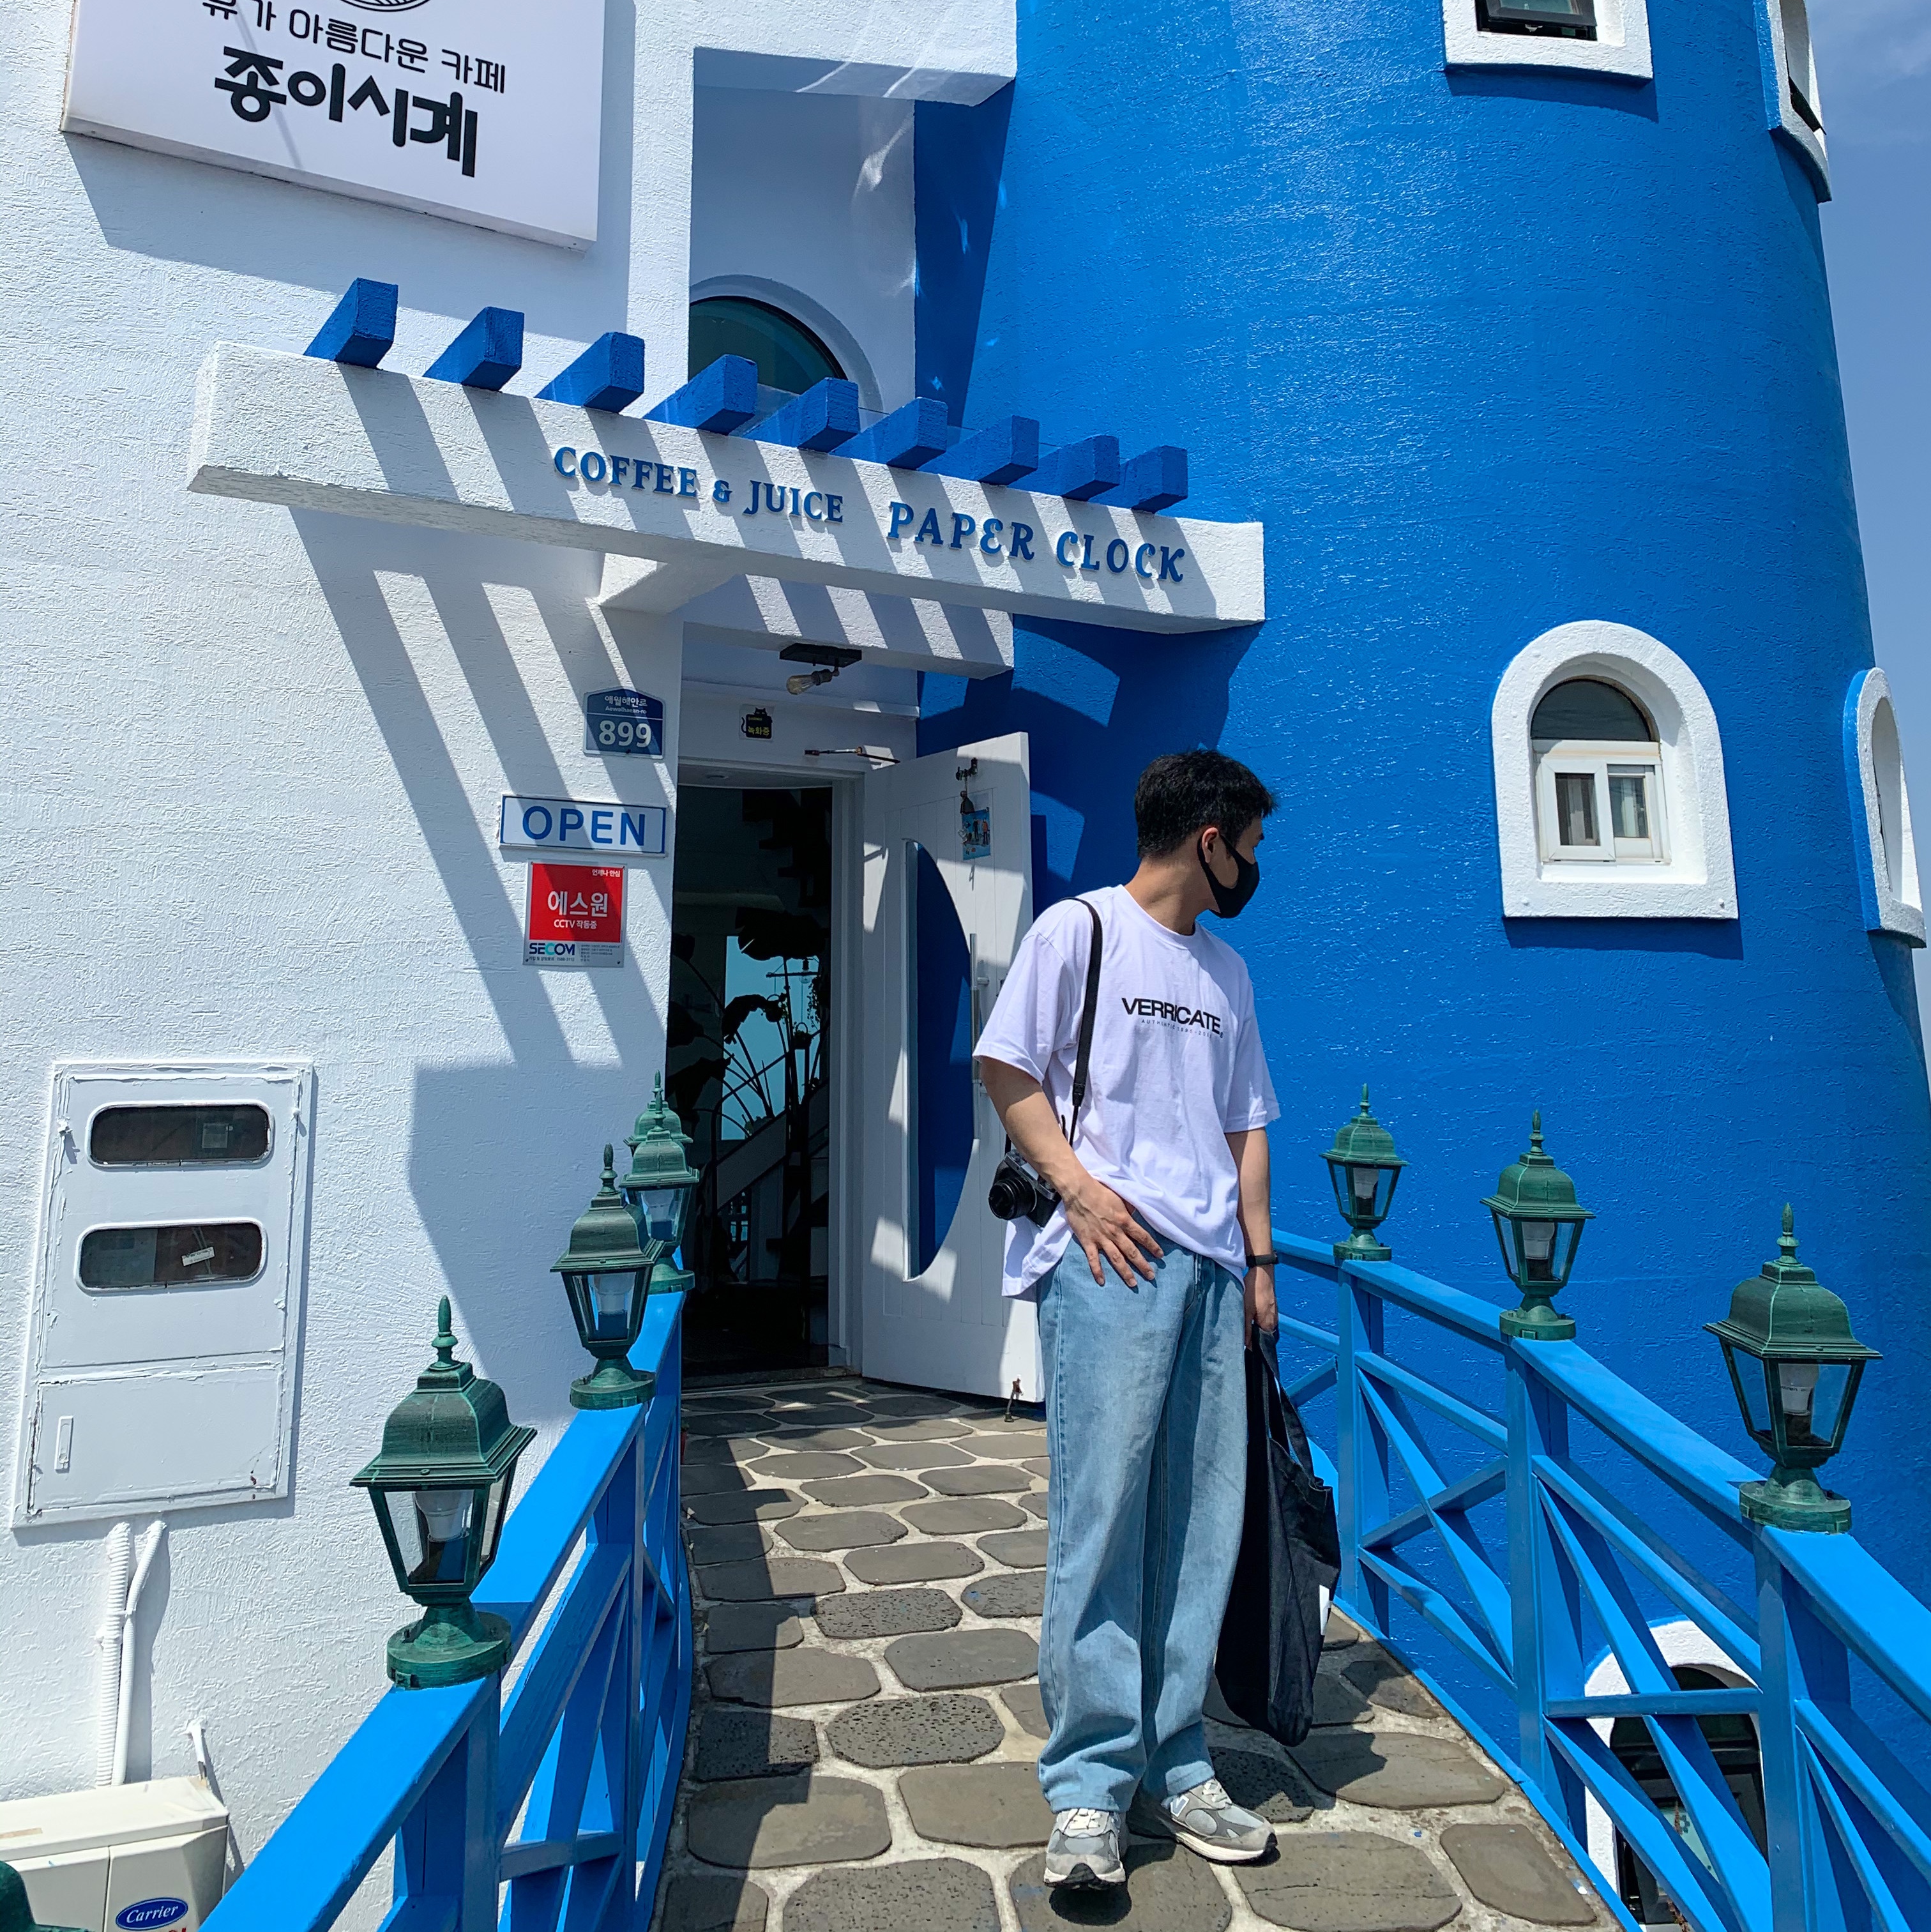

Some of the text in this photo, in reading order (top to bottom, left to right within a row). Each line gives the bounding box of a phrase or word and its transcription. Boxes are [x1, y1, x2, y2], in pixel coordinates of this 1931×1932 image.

[289, 9, 428, 73] 아름다운
[441, 49, 506, 93] 카페
[214, 45, 478, 178] 종이시계
[554, 446, 1186, 582] COFFEE & JUICE PAPER CLOCK
[598, 720, 652, 748] 899
[522, 805, 646, 846] OPEN
[547, 890, 608, 917] 에스원
[554, 919, 598, 929] CCTV 작동중
[529, 943, 575, 955] SECOM
[1121, 997, 1221, 1035] VERRICATE
[126, 1906, 179, 1924] Carrier
